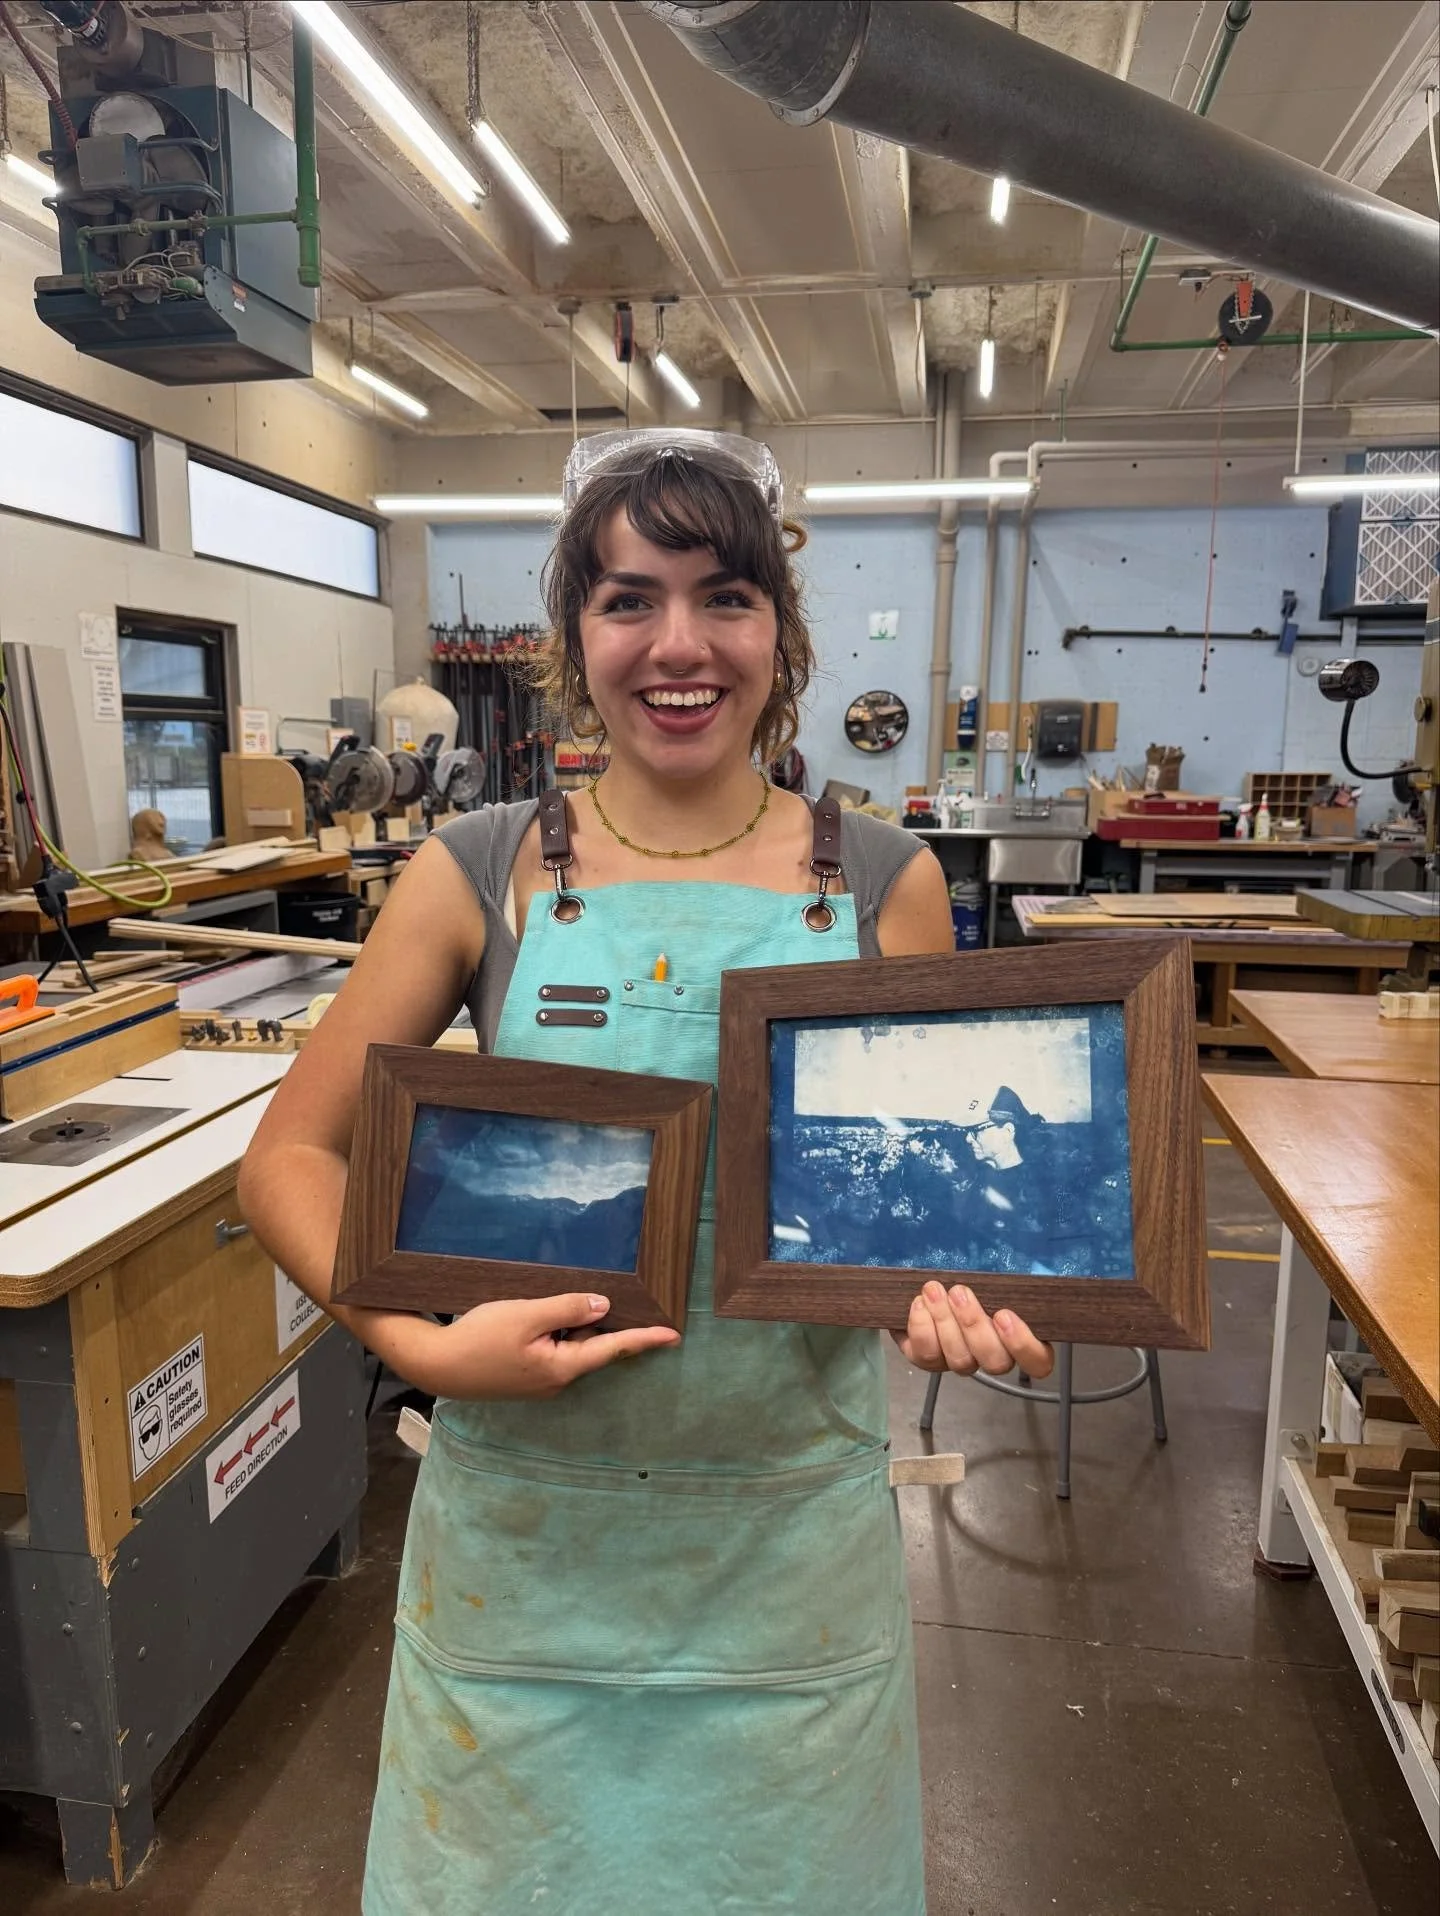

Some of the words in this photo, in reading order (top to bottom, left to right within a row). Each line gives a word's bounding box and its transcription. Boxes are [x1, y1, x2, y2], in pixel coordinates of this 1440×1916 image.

[290, 1304, 318, 1332] COLLEC
[147, 1345, 200, 1399] CAUTION
[168, 1379, 193, 1406] Safety
[169, 1387, 199, 1422] glasses
[170, 1397, 202, 1433] required
[225, 1470, 246, 1500] FEED
[248, 1425, 288, 1474] DIRECTION
